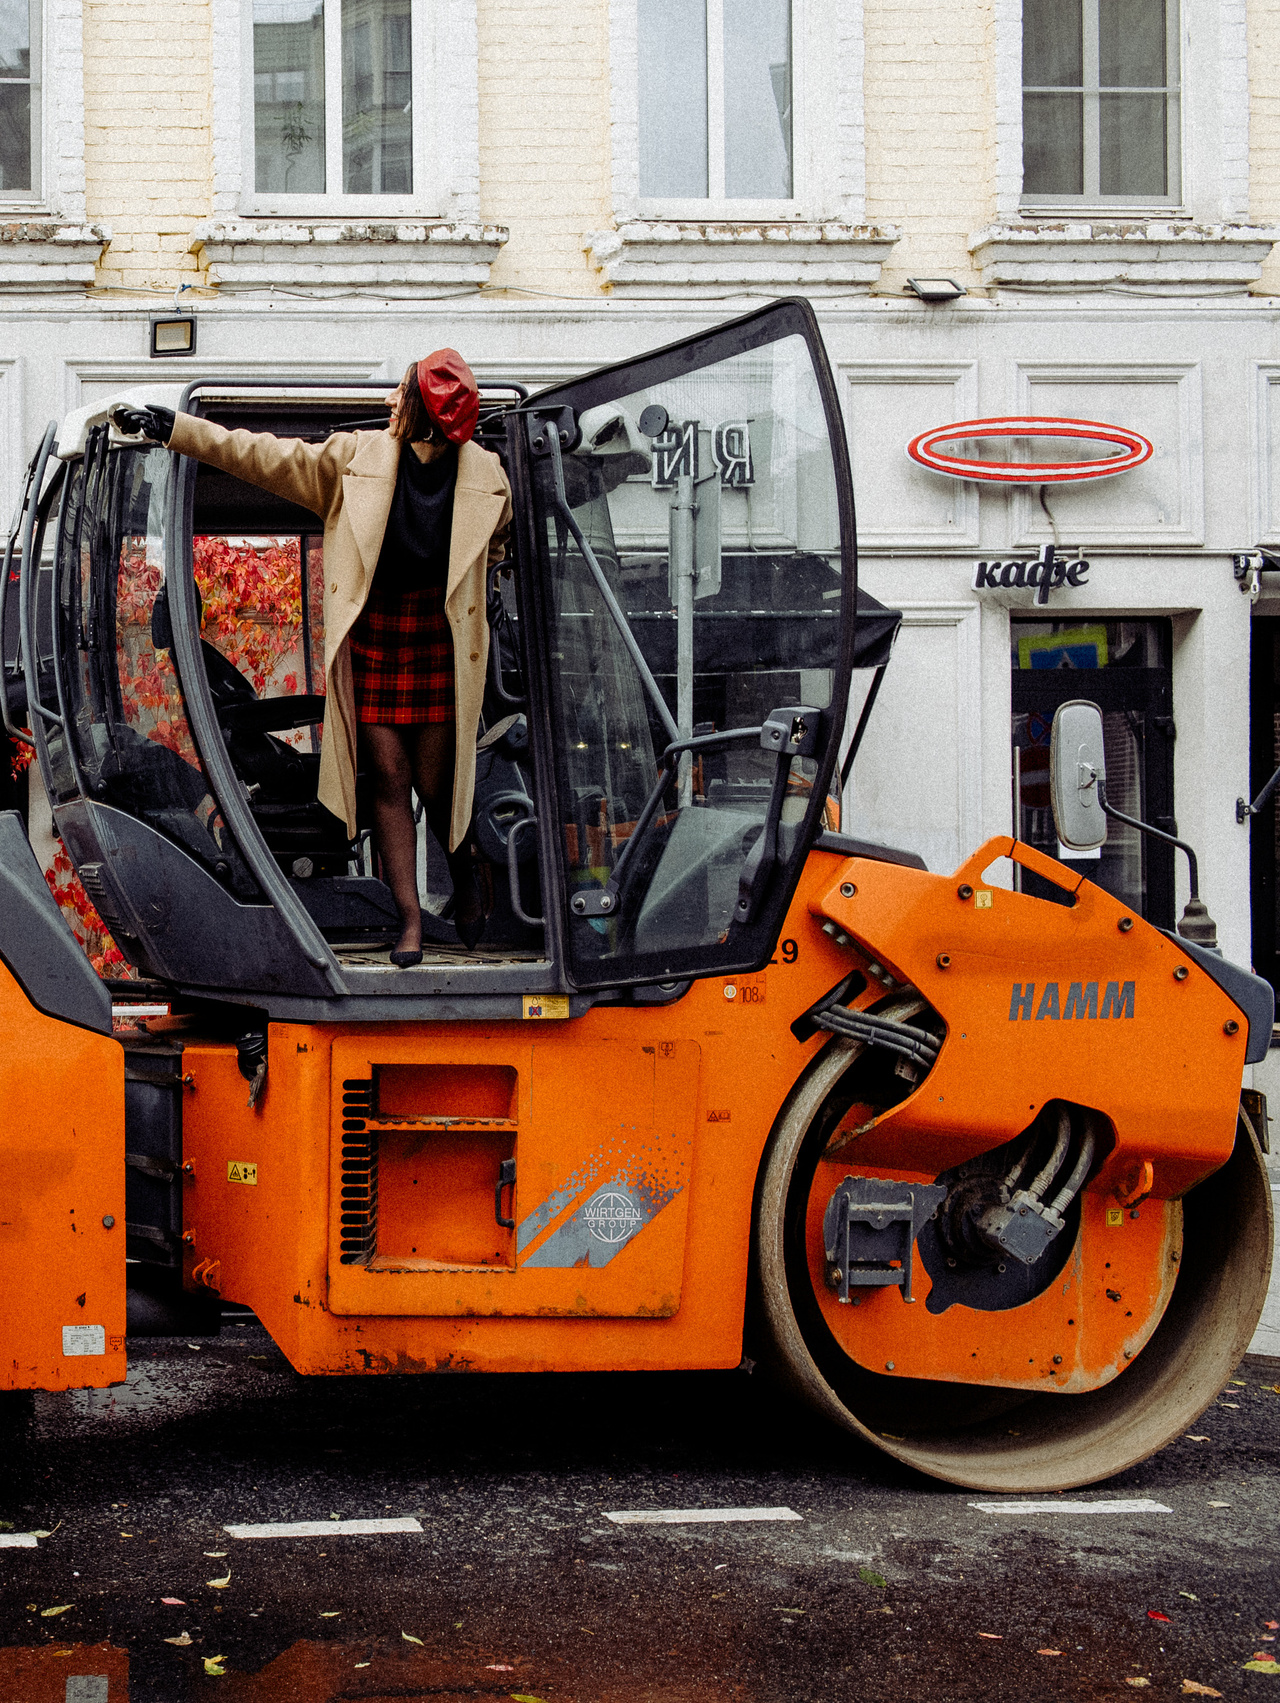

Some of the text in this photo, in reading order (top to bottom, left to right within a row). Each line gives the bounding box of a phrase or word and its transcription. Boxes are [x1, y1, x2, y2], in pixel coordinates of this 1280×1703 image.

[974, 544, 1090, 604] кафе
[1008, 980, 1136, 1021] HAMM
[584, 1207, 641, 1218] WIRTGEN
[587, 1219, 637, 1229] GROUP
